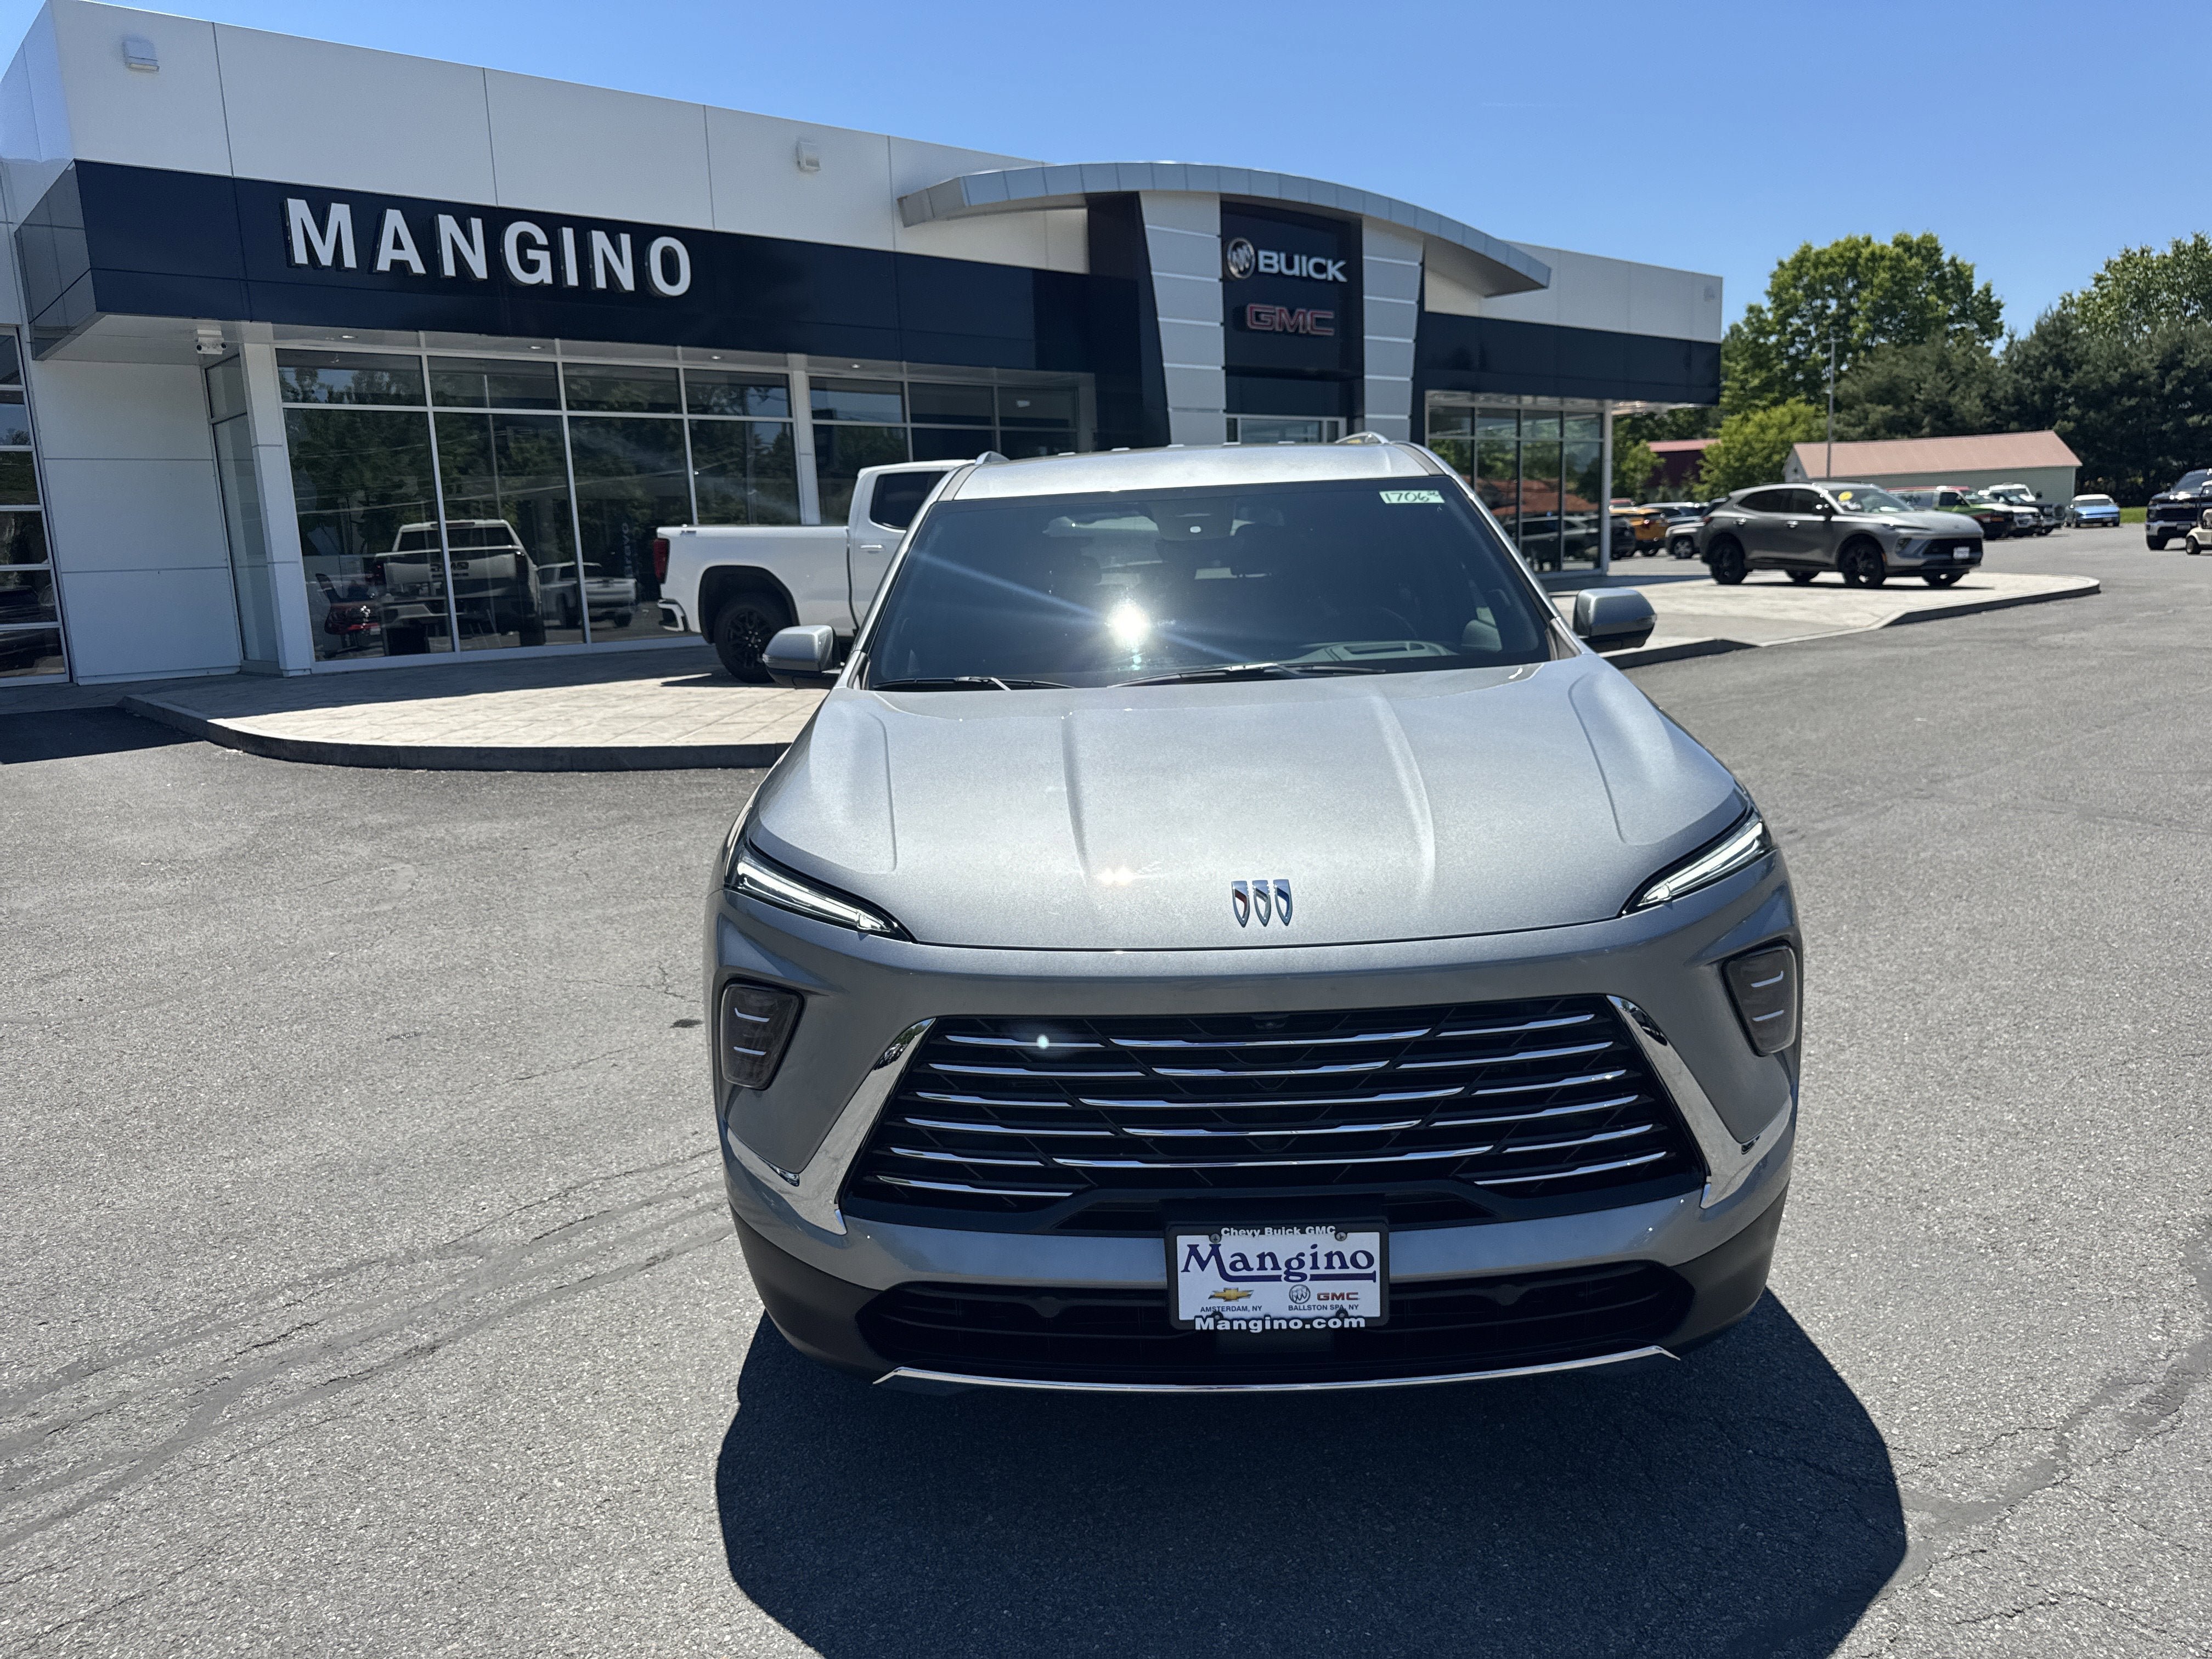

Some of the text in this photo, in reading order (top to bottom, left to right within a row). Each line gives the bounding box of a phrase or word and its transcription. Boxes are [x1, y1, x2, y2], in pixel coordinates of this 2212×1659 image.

[285, 198, 691, 297] MANGINO
[1258, 250, 1347, 283] BUICK
[1246, 303, 1335, 336] GMC
[1221, 1226, 1336, 1238] Chevy Buick GMC
[1181, 1243, 1376, 1283] Mangino
[1317, 1292, 1359, 1301] GMC
[1194, 1315, 1365, 1333] Mangino.com
